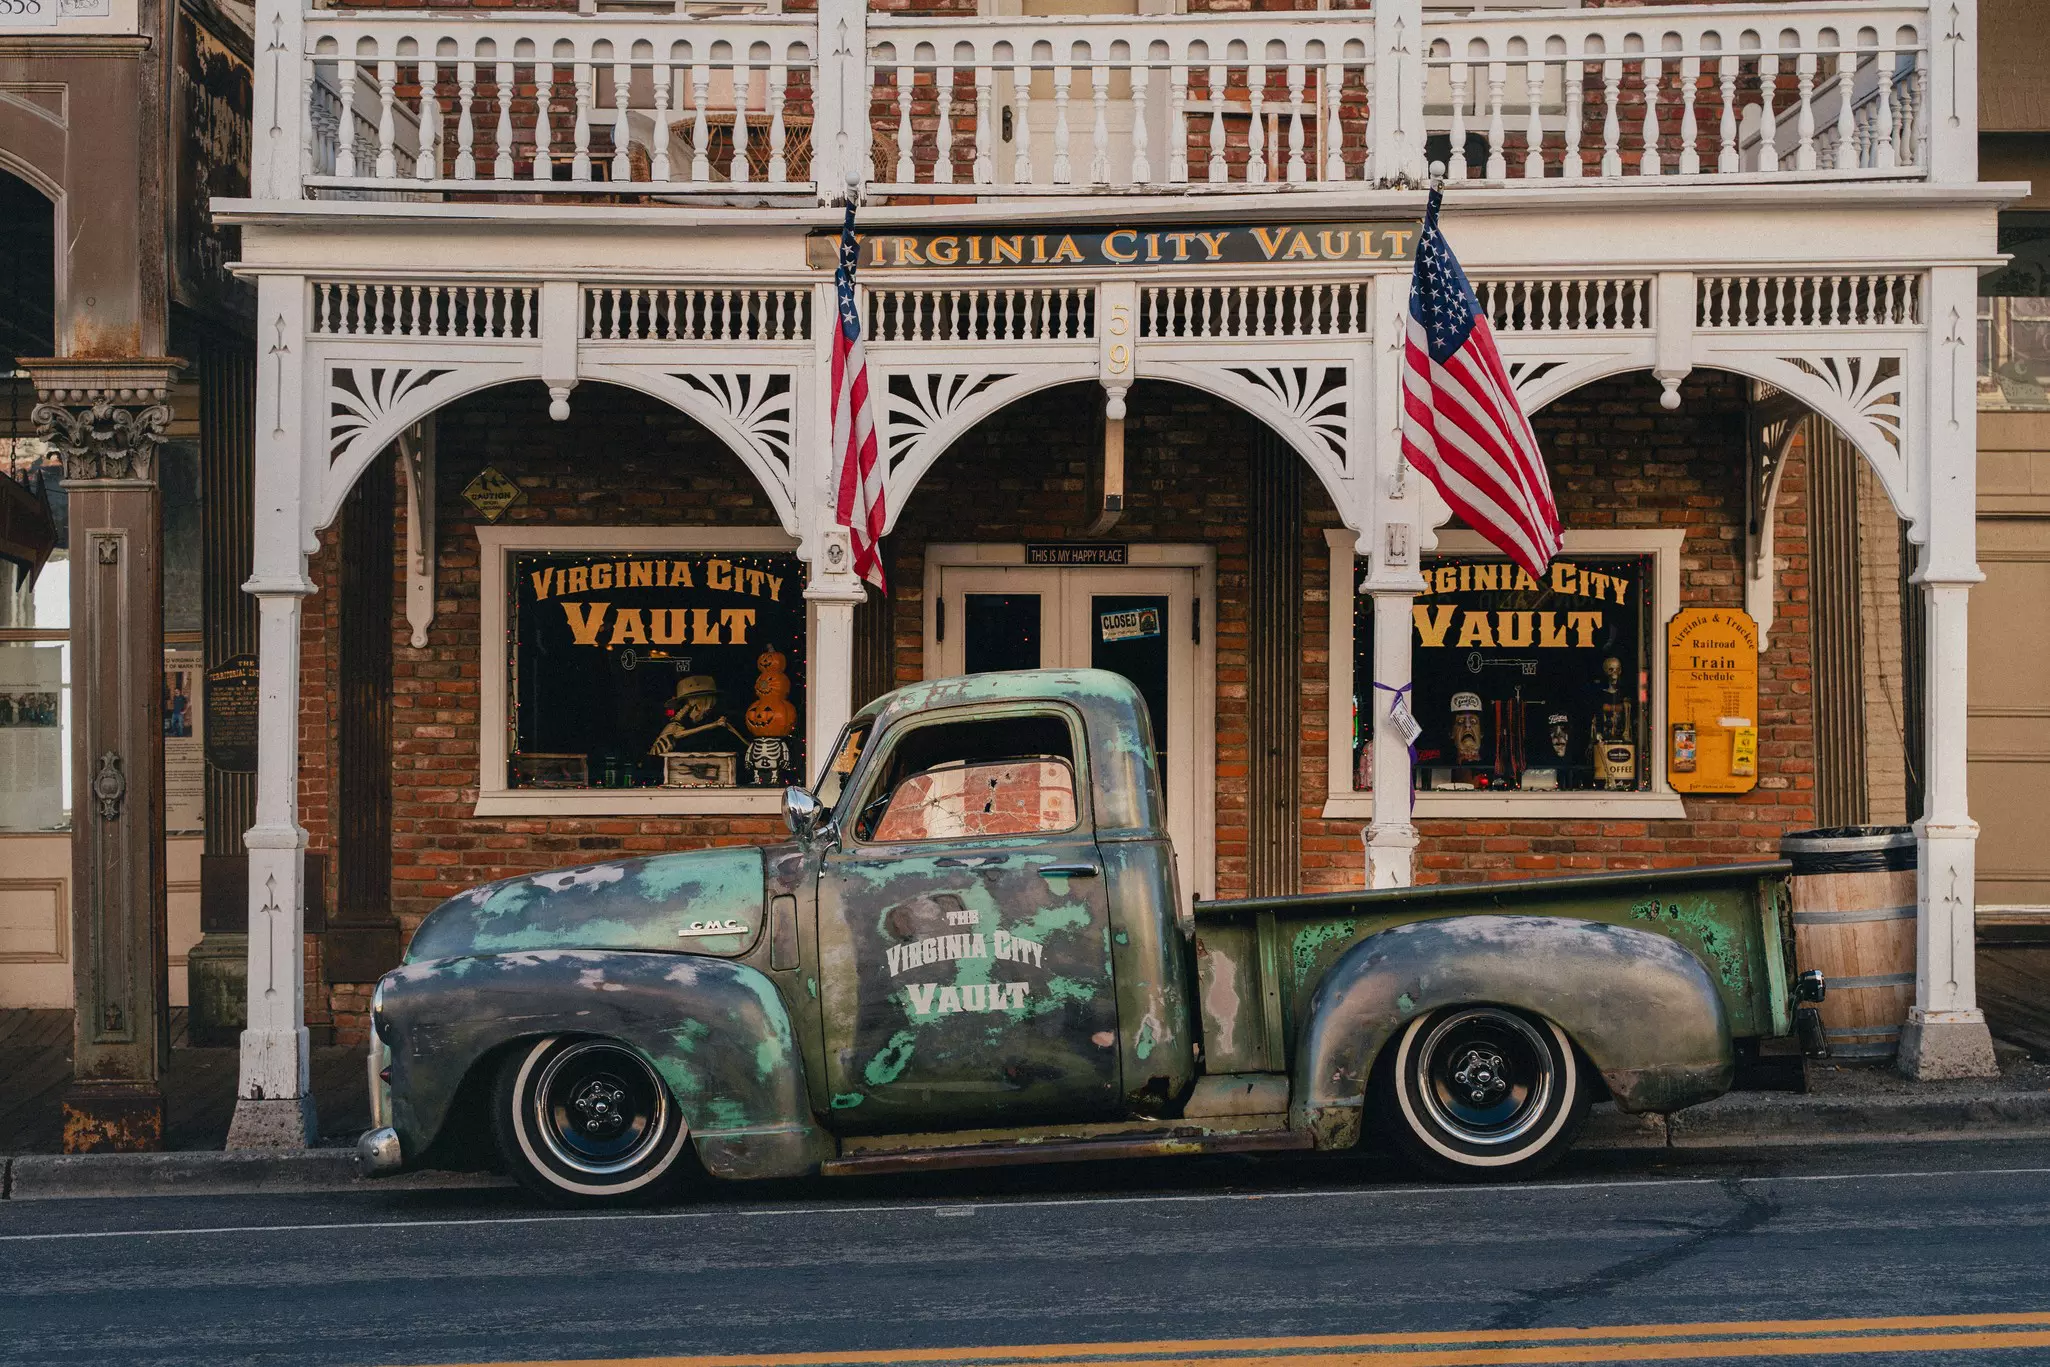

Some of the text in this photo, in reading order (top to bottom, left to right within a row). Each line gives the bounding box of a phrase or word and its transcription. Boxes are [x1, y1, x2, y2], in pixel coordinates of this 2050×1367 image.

[1101, 229, 1230, 262] CITY
[1249, 227, 1413, 260] VAULT
[471, 492, 511, 500] CAUTION
[1031, 549, 1122, 562] THIS IS MY HAPPY PLACE
[531, 559, 784, 602] VIRGINIA CITY
[1551, 562, 1629, 606] CITY
[560, 602, 756, 645] VAULT
[1103, 613, 1137, 630] CLOSED
[1412, 604, 1602, 648] VAULT
[1672, 613, 1755, 650] Virginia & Truckee
[1692, 639, 1736, 649] Railroad
[1690, 655, 1735, 669] Train
[1690, 671, 1735, 681] Schedule
[1609, 765, 1633, 773] OFFEE
[946, 909, 979, 926] THE
[886, 929, 1043, 977] VIRGINIA CITY
[905, 982, 1030, 1014] VAULT
